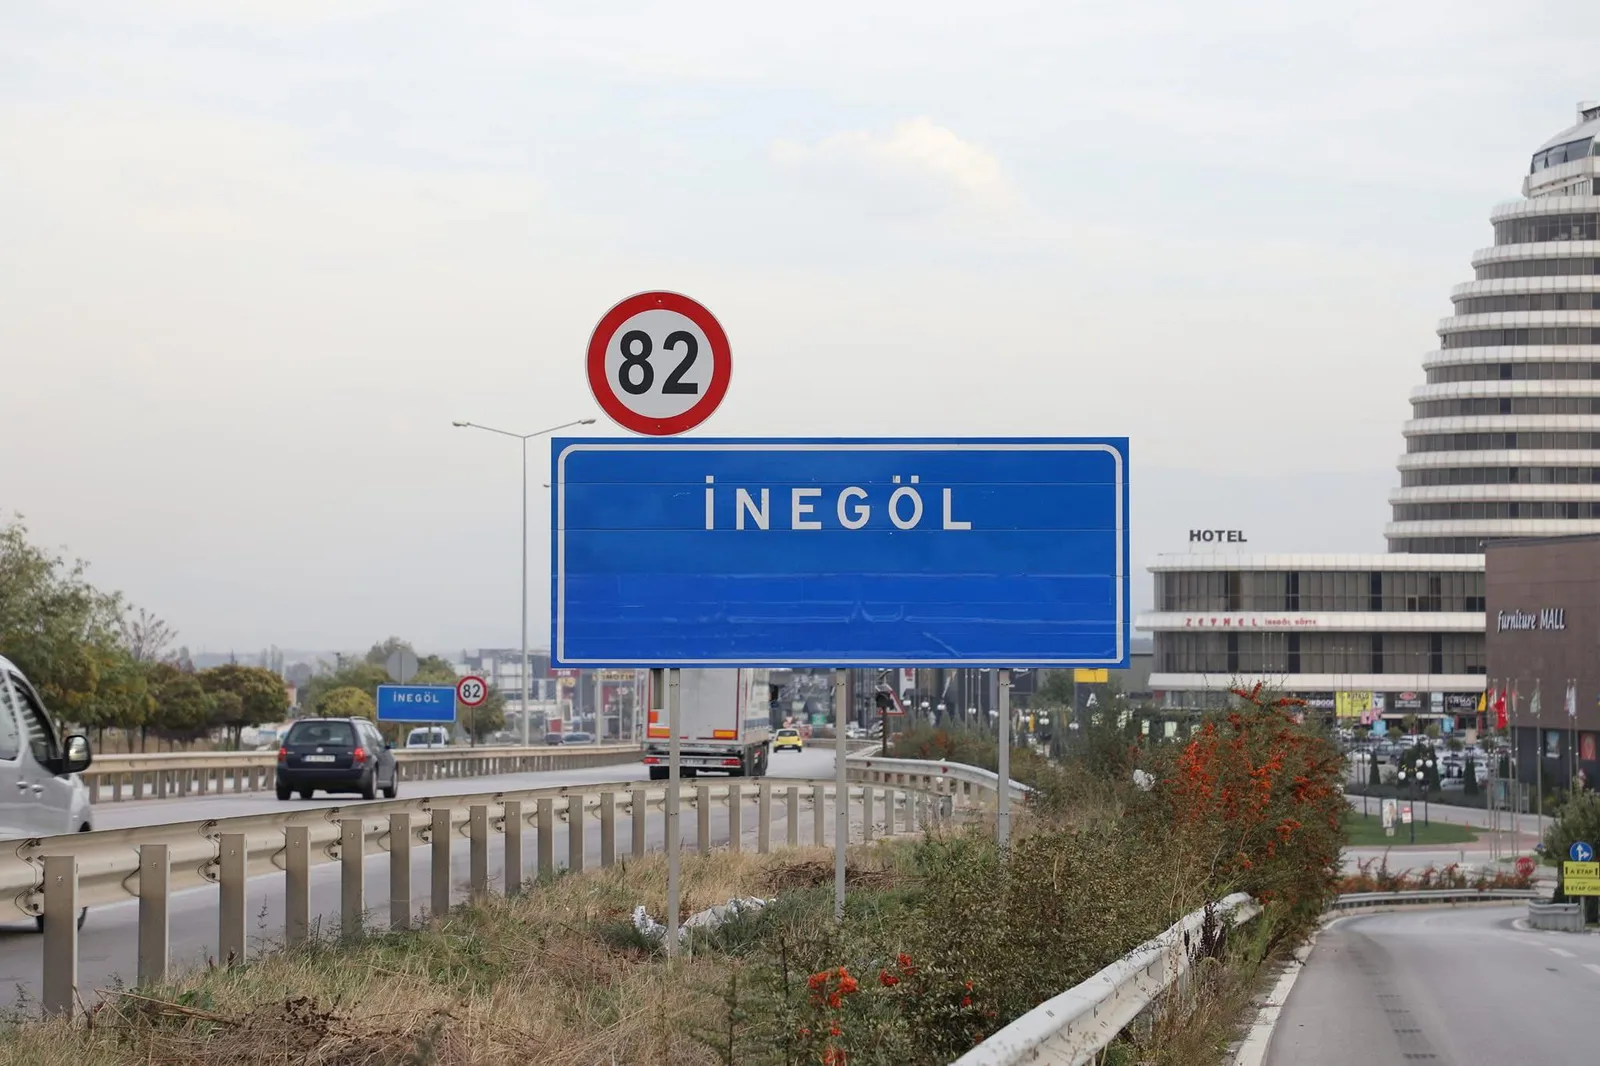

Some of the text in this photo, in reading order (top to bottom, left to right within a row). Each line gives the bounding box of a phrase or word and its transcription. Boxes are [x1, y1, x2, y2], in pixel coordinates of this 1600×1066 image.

[618, 329, 699, 395] 82
[705, 475, 973, 531] İNEGÖL
[1189, 529, 1248, 543] HOTEL
[1497, 608, 1565, 633] furniture MALL
[393, 691, 440, 703] İNEGÖL
[462, 683, 481, 699] 82
